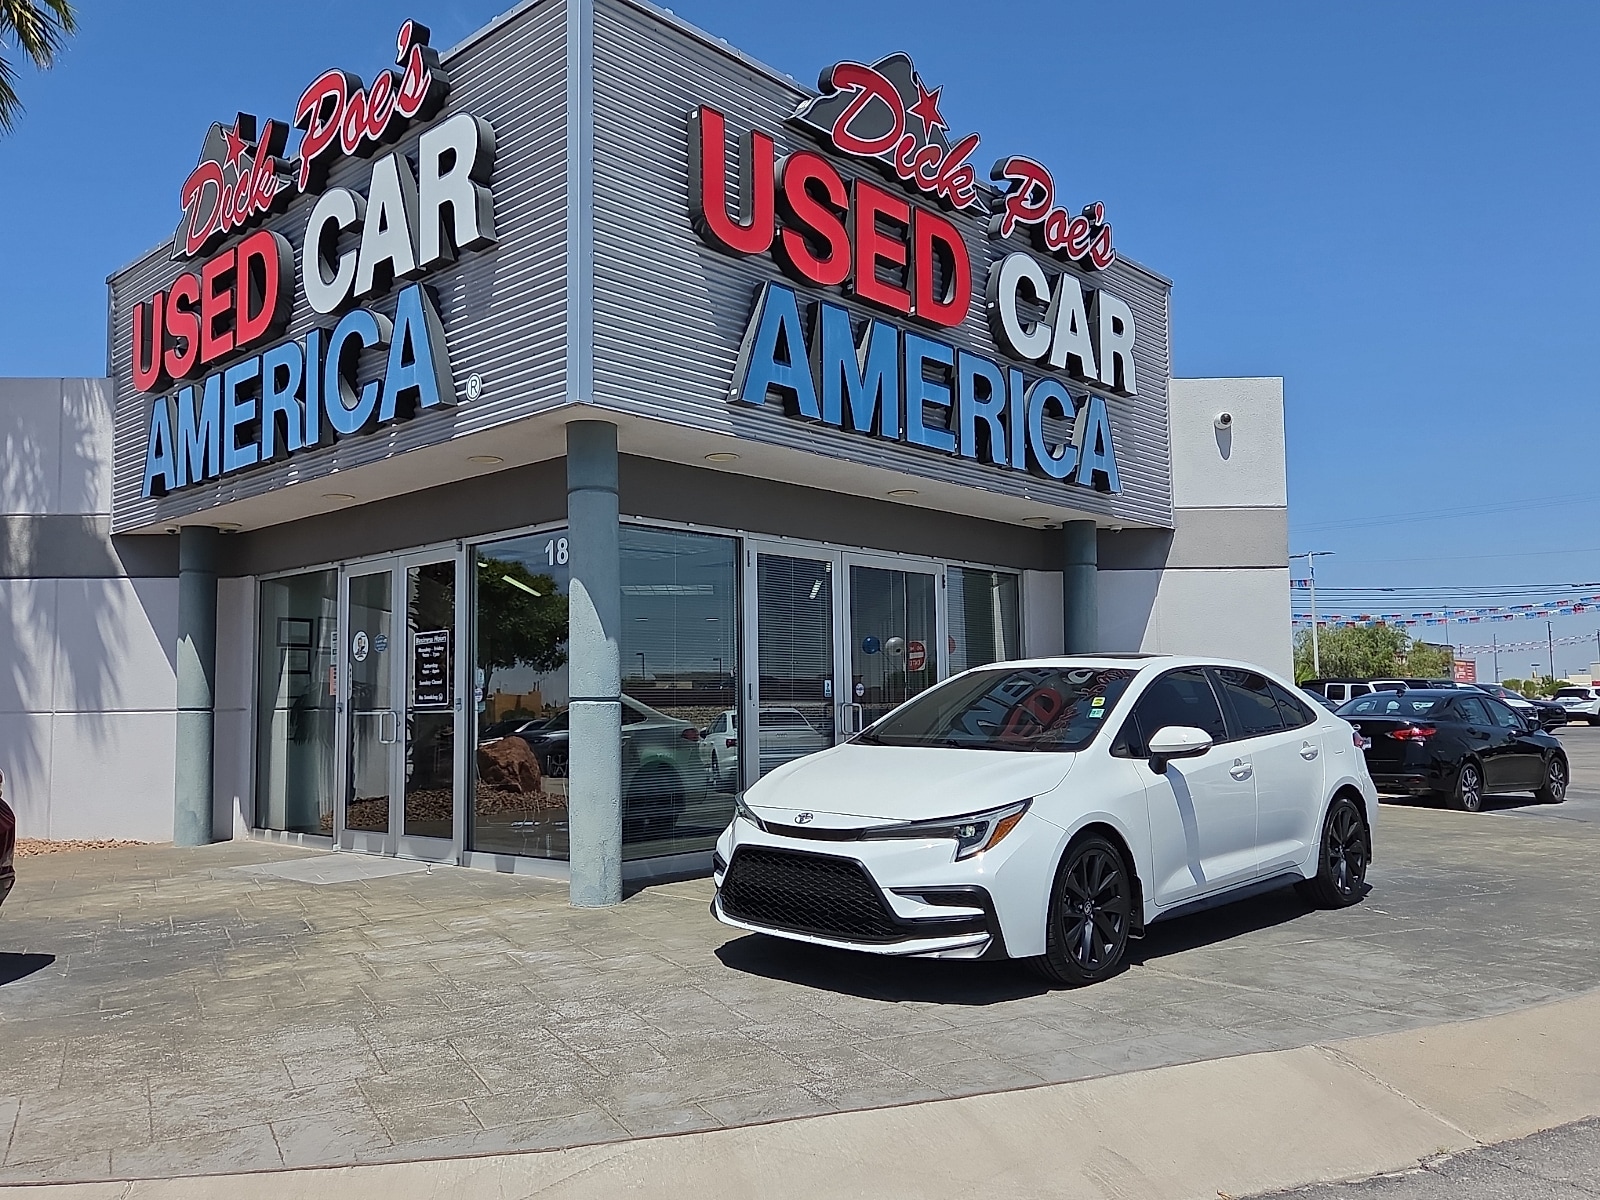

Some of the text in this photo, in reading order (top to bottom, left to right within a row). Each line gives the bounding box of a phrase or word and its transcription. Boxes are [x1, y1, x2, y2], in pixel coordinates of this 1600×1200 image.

[181, 19, 431, 257] Dick Poe's
[700, 105, 1138, 396] USED CAR
[831, 61, 1117, 270] Dick Poe's
[132, 113, 483, 393] USED CAR
[141, 282, 440, 499] AMERICA
[740, 281, 1122, 494] AMERICA
